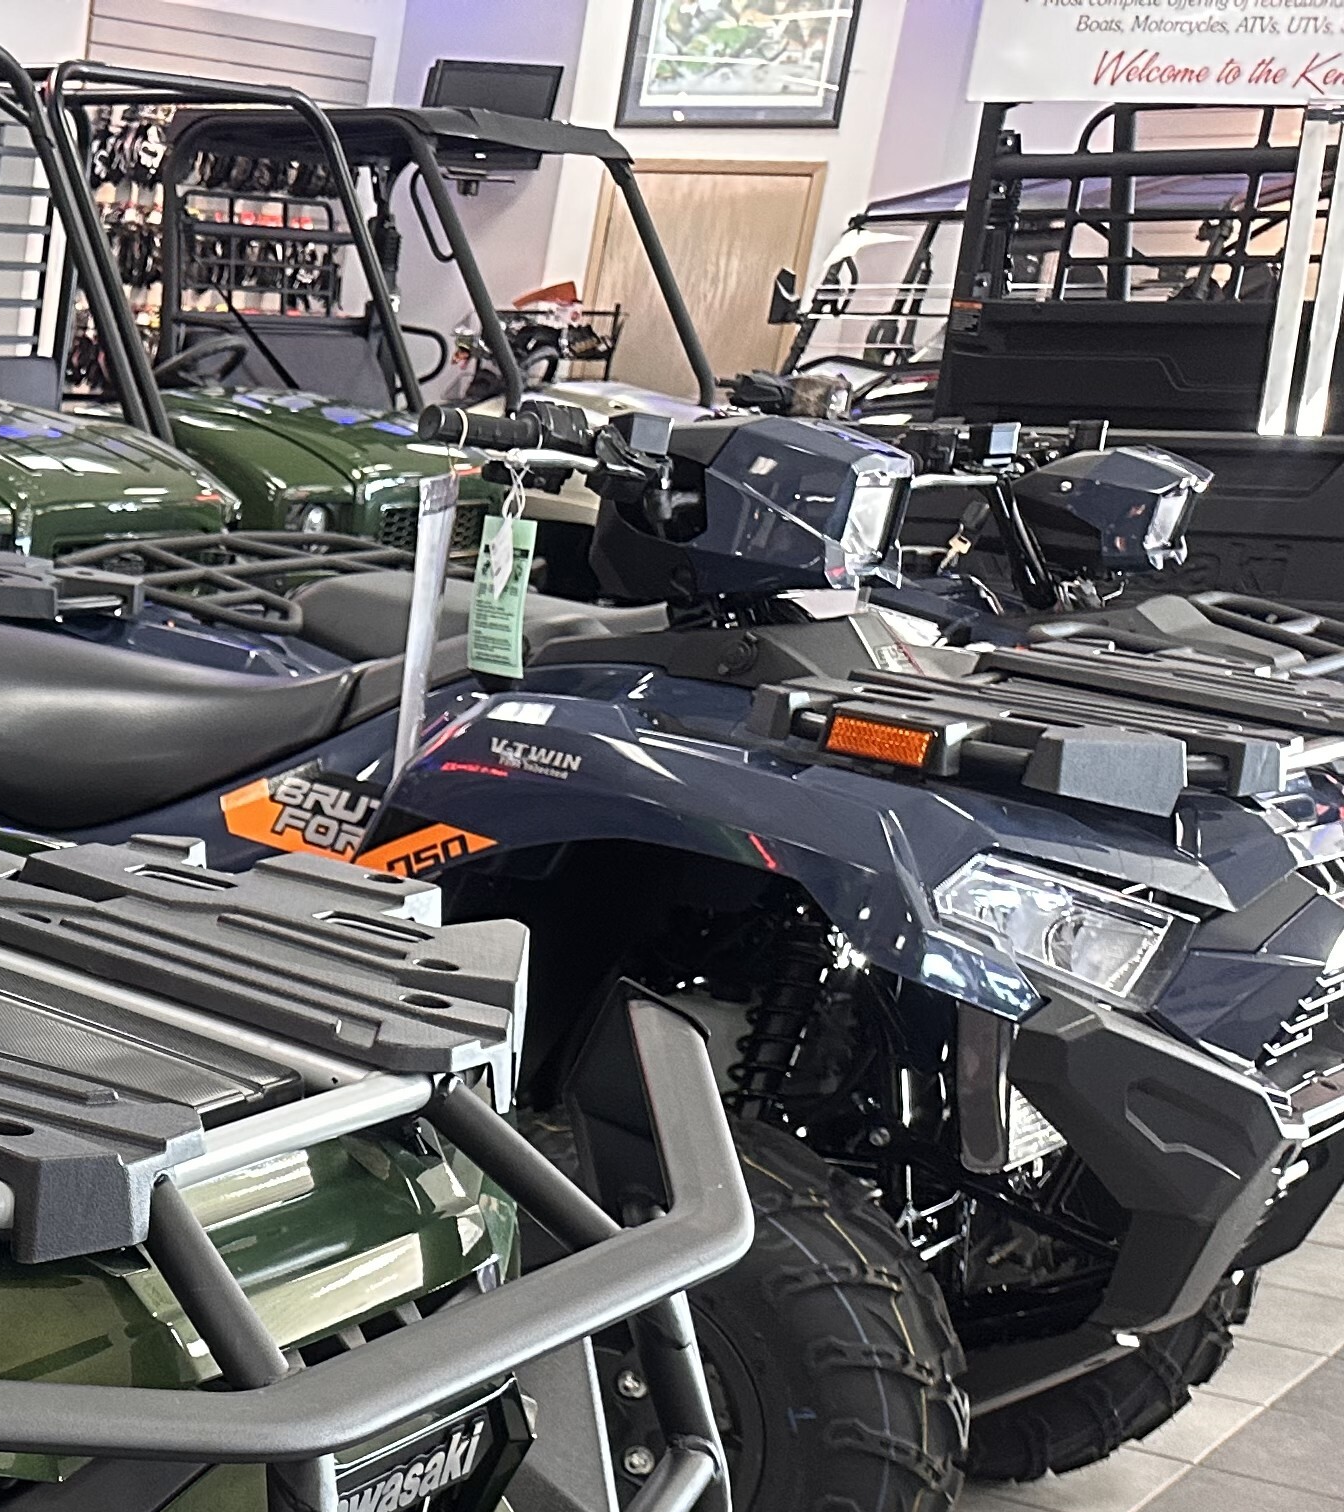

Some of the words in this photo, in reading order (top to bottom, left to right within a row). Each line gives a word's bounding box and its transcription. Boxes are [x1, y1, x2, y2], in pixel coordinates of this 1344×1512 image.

[1076, 14, 1124, 33] Boats,
[1131, 14, 1230, 36] Motorcycles,
[1235, 16, 1280, 35] ATVs,
[1287, 16, 1334, 35] UTVs,
[1092, 48, 1210, 87] Welcome
[1216, 58, 1241, 86] to
[1248, 56, 1287, 85] the
[491, 736, 582, 772] V-TWIN
[274, 777, 381, 824] BRU
[272, 806, 364, 860] FOR
[387, 834, 471, 880] 750
